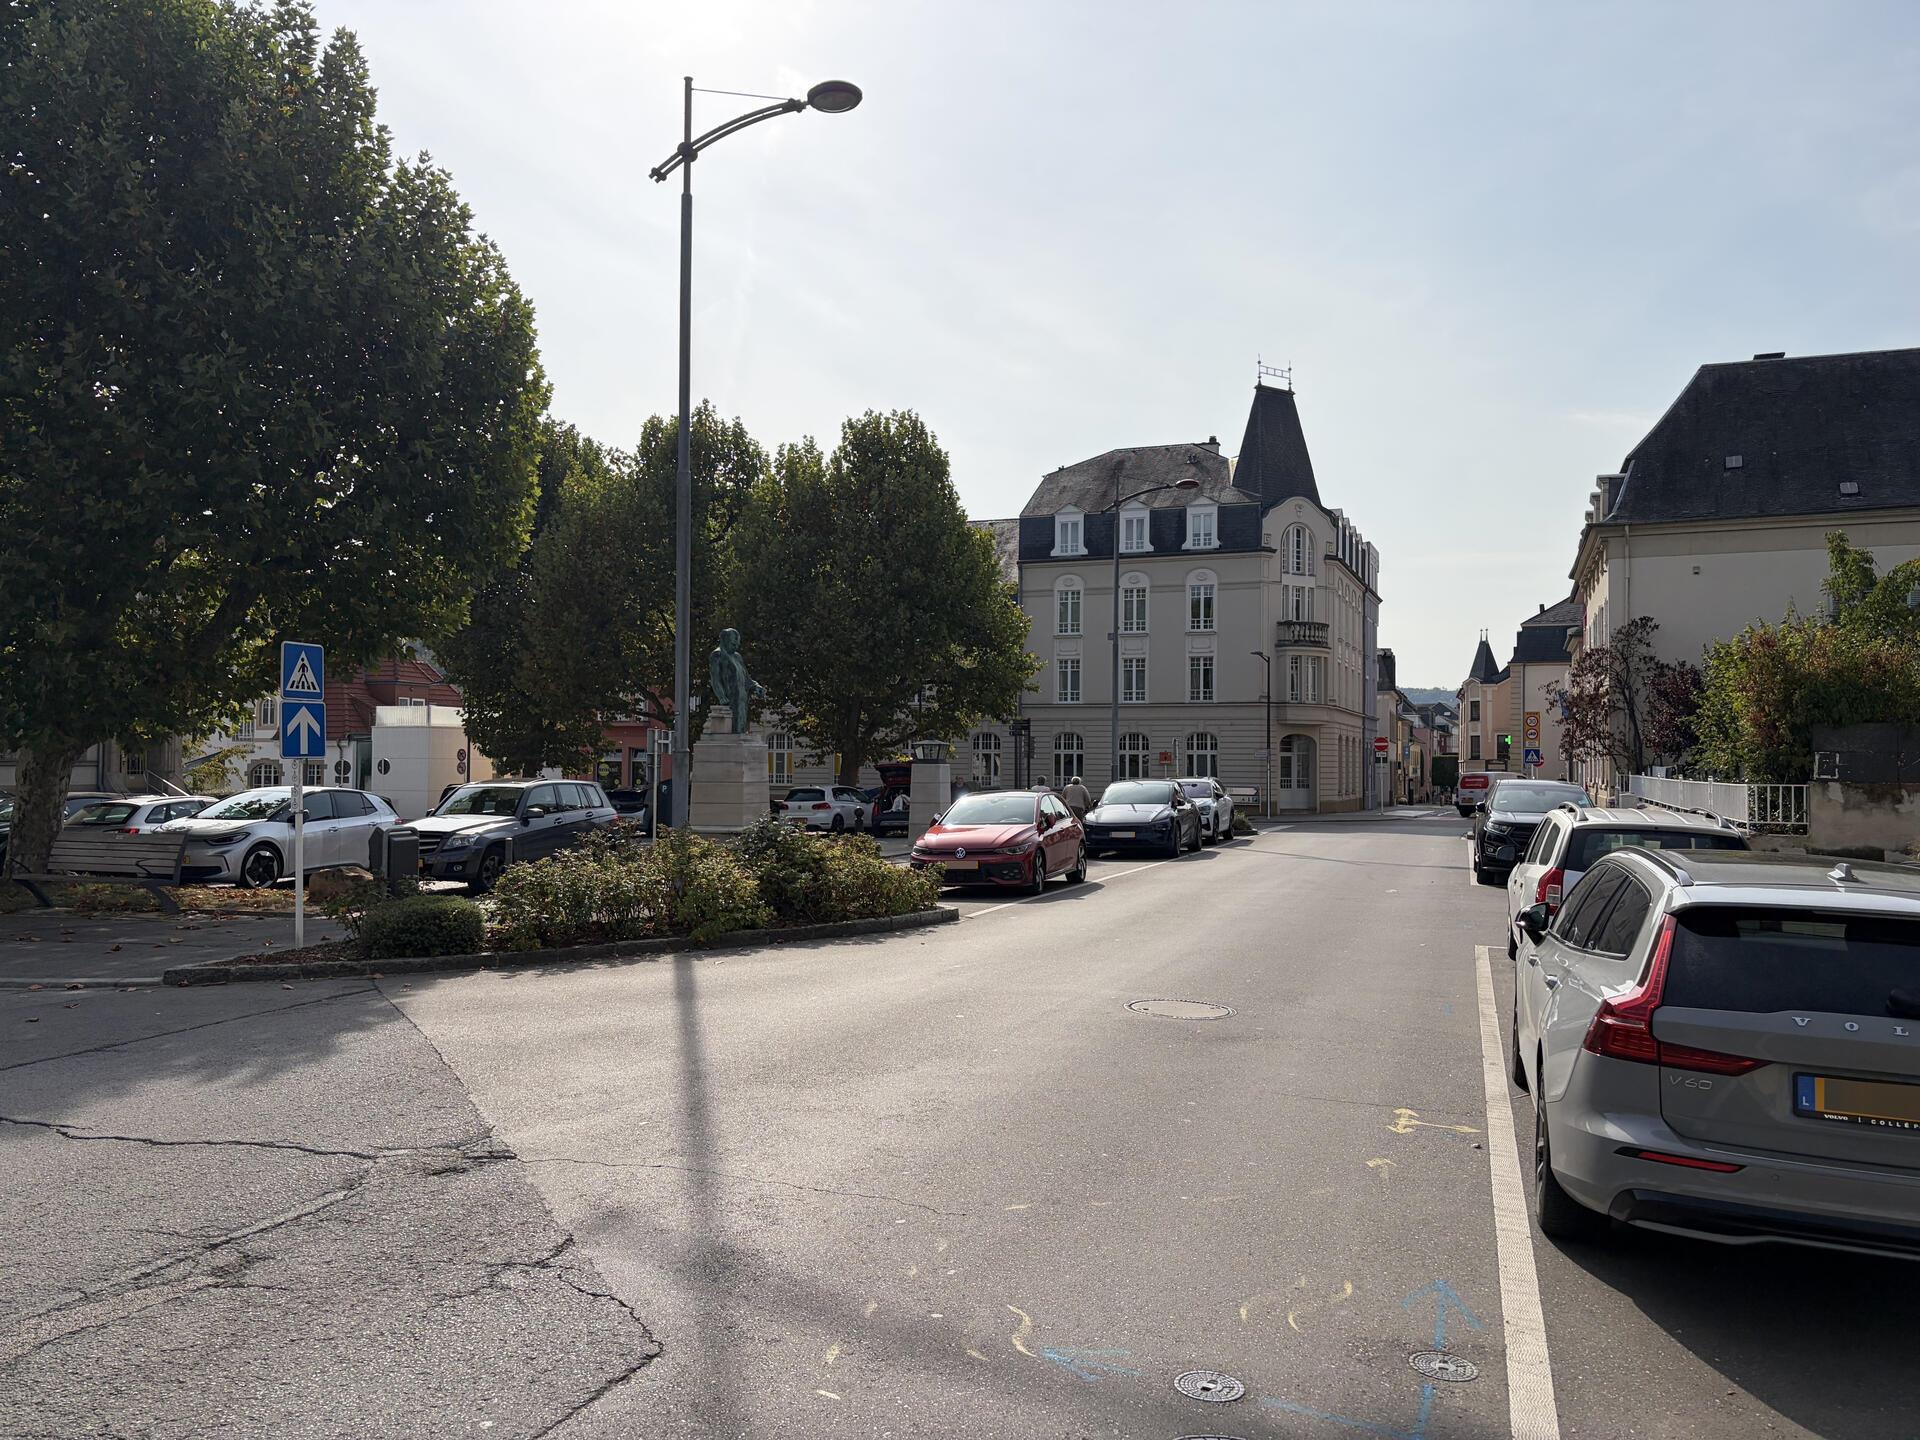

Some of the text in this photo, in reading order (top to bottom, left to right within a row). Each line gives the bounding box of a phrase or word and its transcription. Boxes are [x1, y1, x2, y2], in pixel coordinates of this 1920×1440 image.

[1669, 1075, 1713, 1090] V60
[1802, 1095, 1810, 1106] L
[1823, 1113, 1849, 1122] VOLVO
